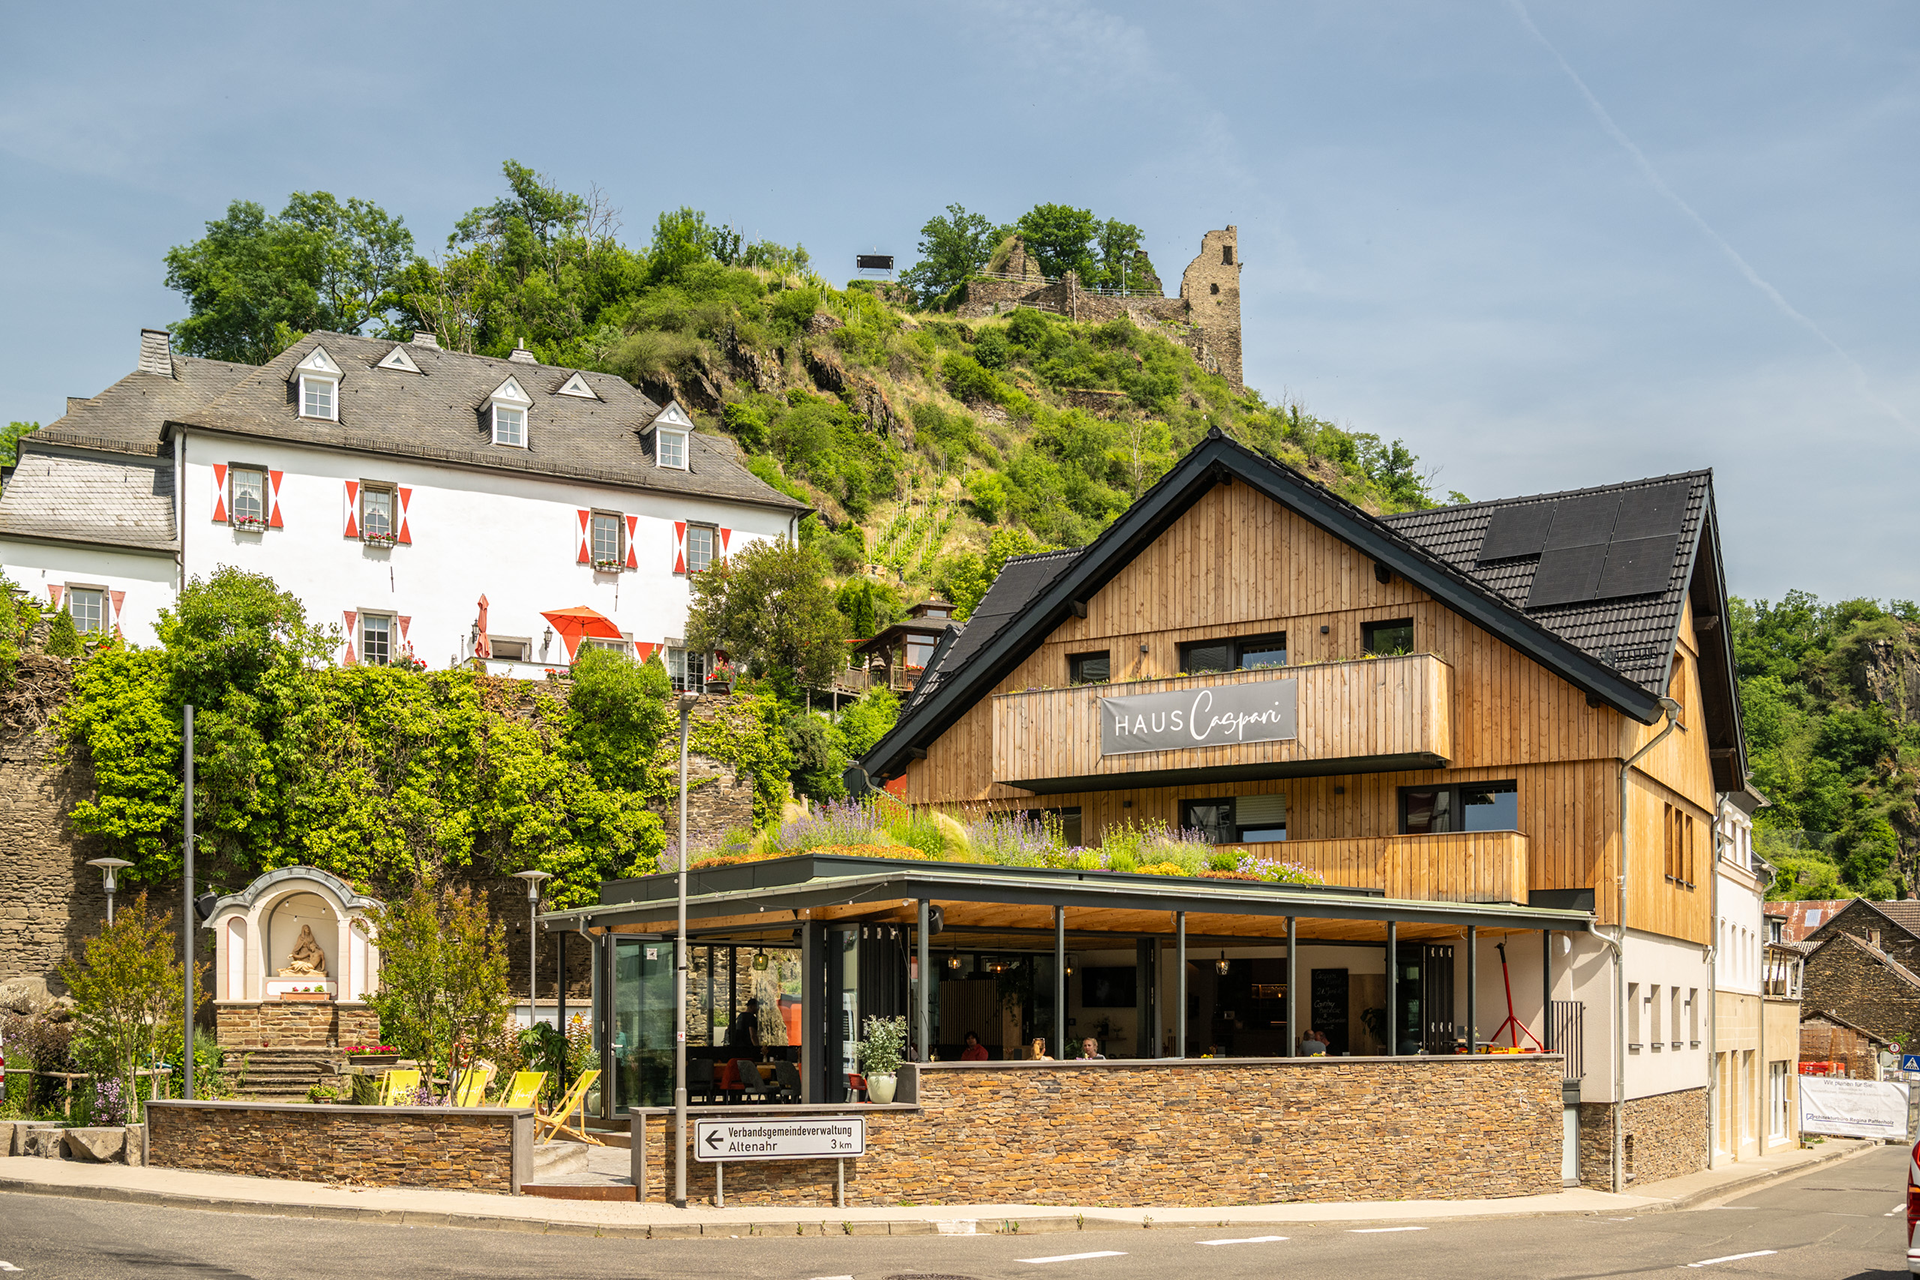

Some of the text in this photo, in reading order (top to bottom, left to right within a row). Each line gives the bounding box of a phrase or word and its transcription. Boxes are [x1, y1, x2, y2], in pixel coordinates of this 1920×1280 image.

[1115, 690, 1281, 741] HAUS Caspari
[728, 1125, 852, 1139] Verbandsgemeindeverwaltung
[728, 1138, 852, 1152] Altenahr 3 km
